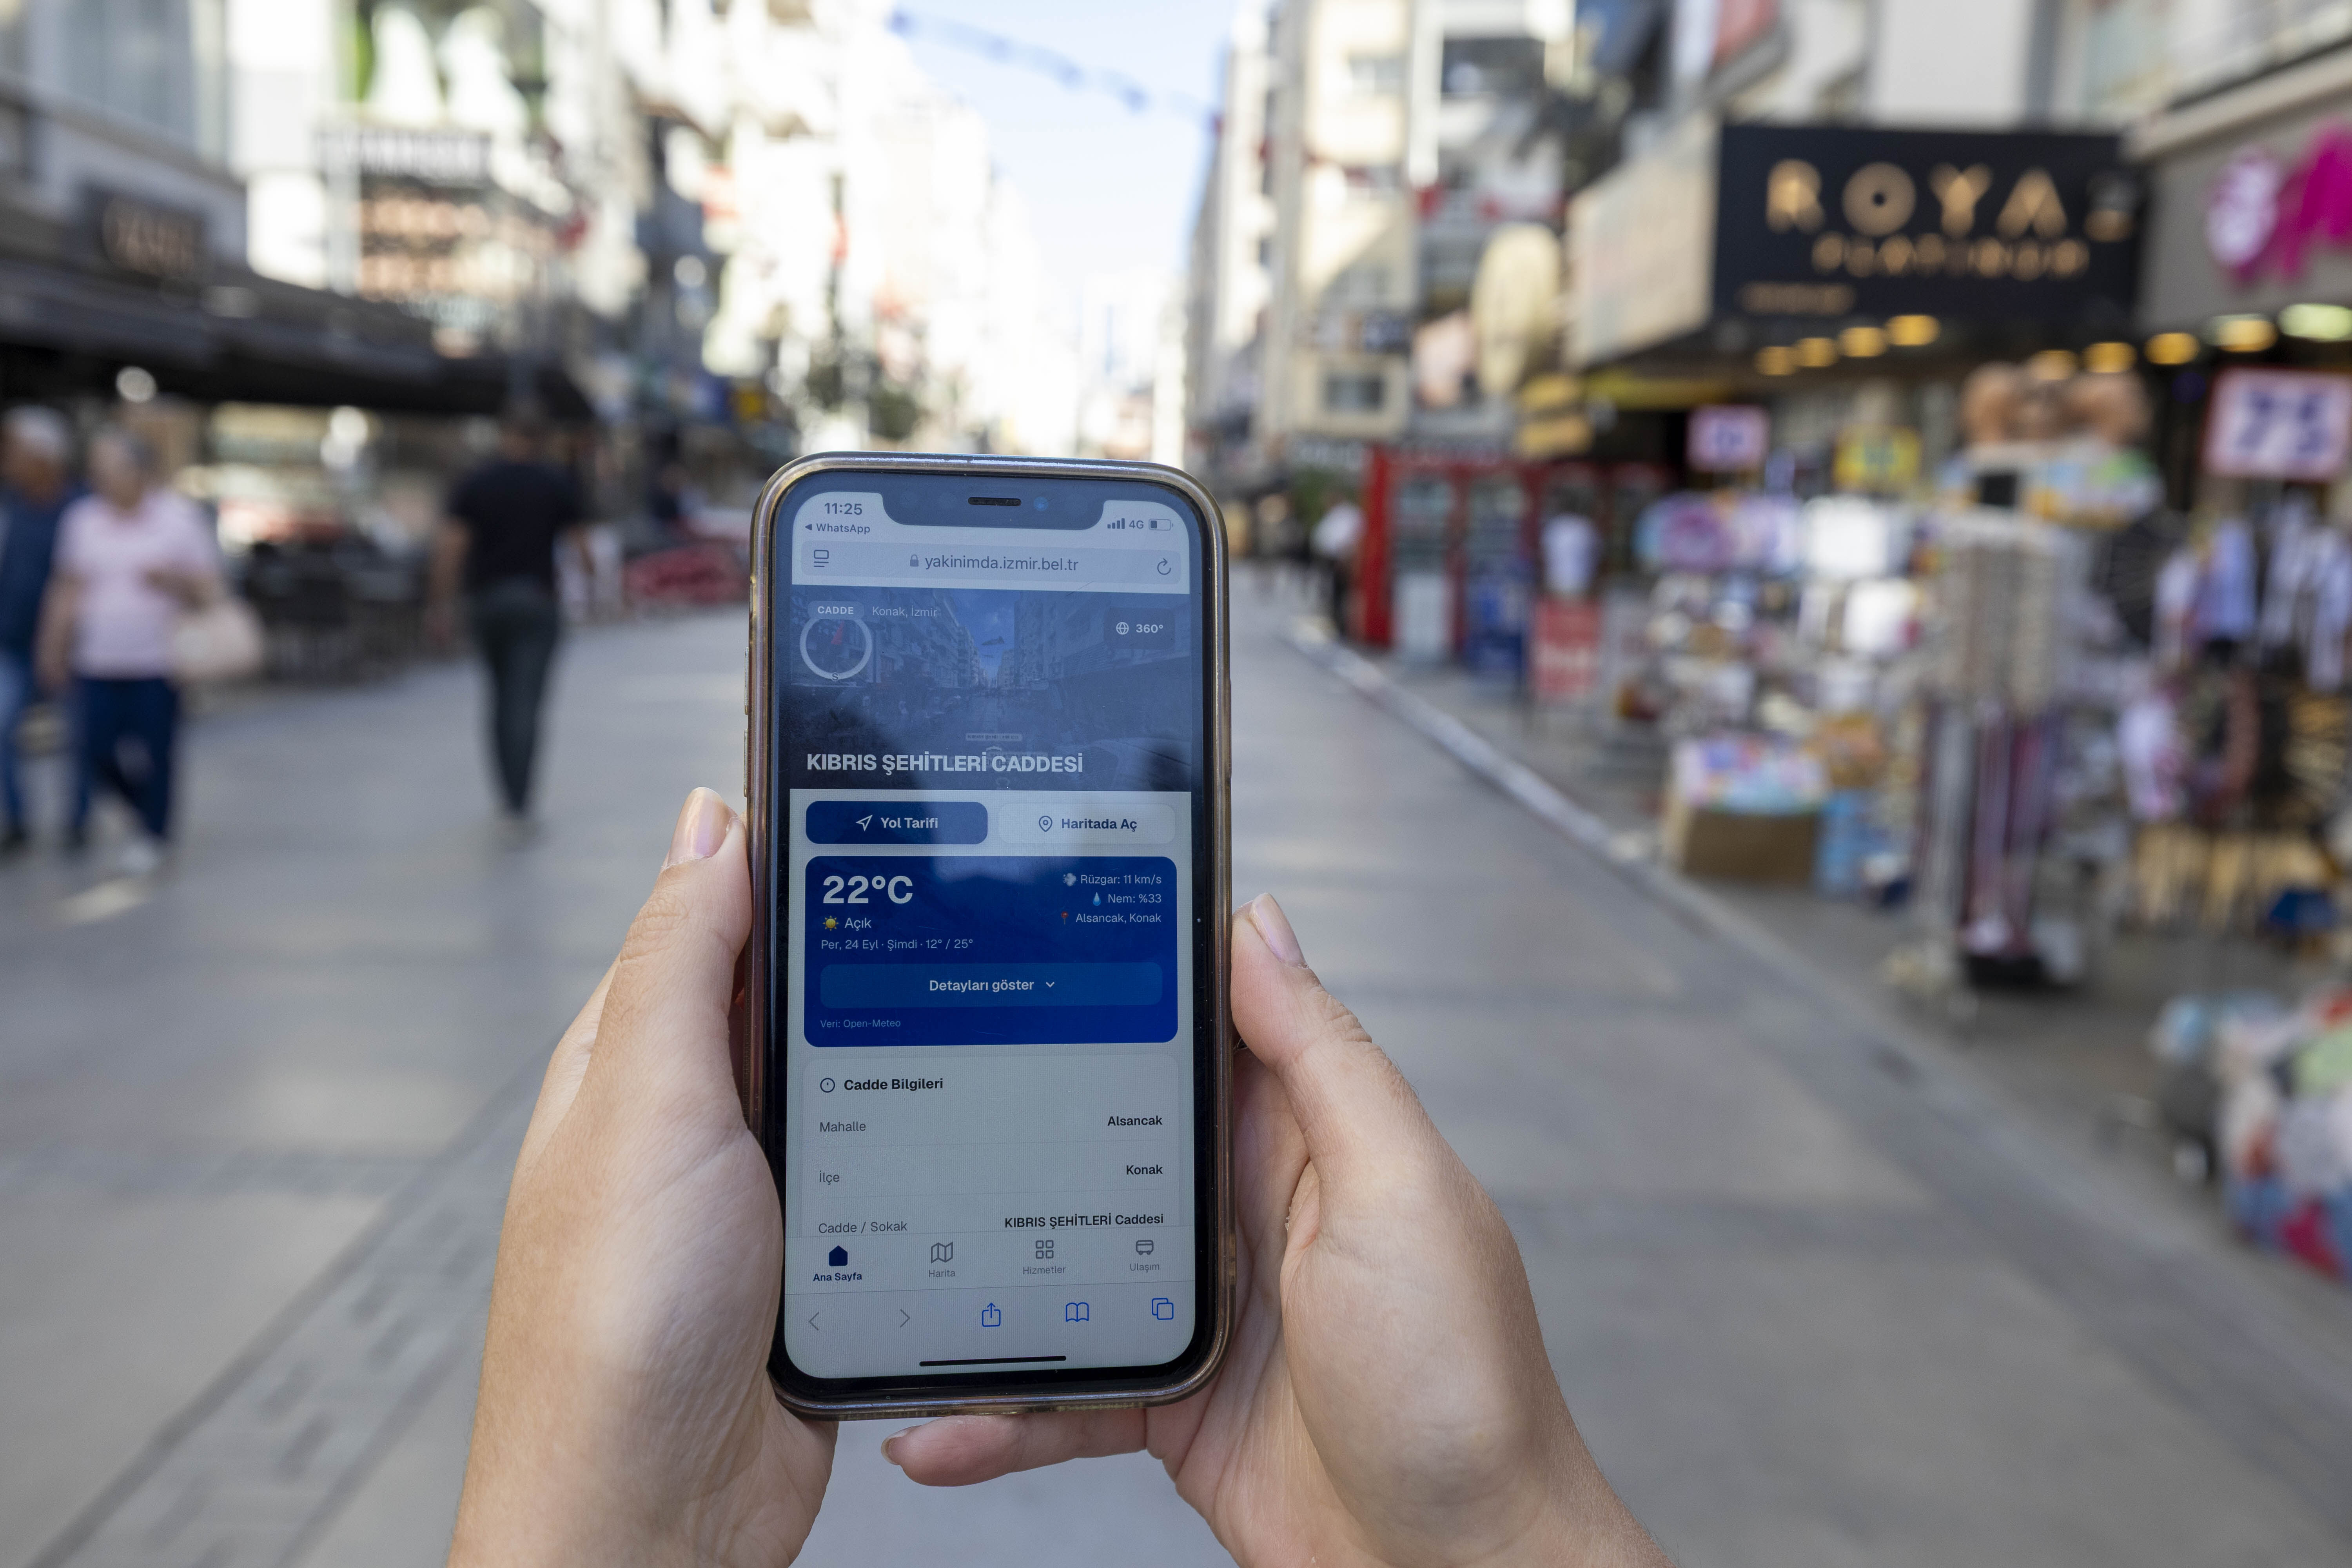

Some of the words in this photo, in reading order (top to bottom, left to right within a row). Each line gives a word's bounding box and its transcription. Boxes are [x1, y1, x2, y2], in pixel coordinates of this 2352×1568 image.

[1765, 158, 2070, 237] ROYA
[824, 503, 862, 515] 11:25
[816, 523, 871, 535] WhatsApp
[1129, 520, 1144, 529] 4G
[925, 555, 1079, 571] yakinimda.izmir.bel.tr
[817, 606, 853, 615] CADDE
[872, 606, 908, 618] Konak,
[910, 605, 938, 617] İzmir
[1136, 624, 1163, 633] 360°
[808, 754, 877, 770] KIBRIS
[882, 751, 986, 776] ŞEHİTLERİ
[991, 753, 1083, 773] CADDESİ
[880, 817, 902, 828] Yol
[904, 817, 938, 828] Tarifi
[1062, 818, 1117, 829] Haritada
[1120, 818, 1137, 832] Aç
[1080, 874, 1120, 886] Rüzgar:
[1123, 875, 1131, 884] 11
[1134, 874, 1162, 885] km/s
[823, 875, 913, 904] 22°C
[1108, 894, 1135, 903] Nem:
[1138, 893, 1162, 903] %33
[844, 917, 871, 931] Açık
[1075, 913, 1127, 924] Alsancak,
[1129, 913, 1161, 922] Konak
[821, 939, 842, 951] Per,
[845, 939, 859, 949] 24
[862, 939, 878, 951] Eyl
[887, 939, 917, 951] Şimdi
[926, 939, 942, 949] 12°
[954, 938, 973, 949] 25°
[929, 980, 988, 993] Detayları
[992, 979, 1034, 993] göster
[820, 1020, 840, 1028] Veri:
[843, 1019, 901, 1029] Open-Meteo
[844, 1079, 888, 1091] Cadde
[891, 1078, 943, 1091] Bilgileri
[820, 1121, 866, 1132] Mahalle
[1107, 1115, 1162, 1126] Alsancak
[1126, 1164, 1163, 1175] Konak
[819, 1170, 840, 1185] İlçe
[1005, 1217, 1046, 1228] KIBRIS
[1049, 1212, 1111, 1230] ŞEHİTLERİ
[1115, 1213, 1163, 1225] Caddesi
[818, 1222, 857, 1234] Cadde
[871, 1221, 907, 1232] Sokak
[929, 1269, 956, 1278] Harita
[1023, 1266, 1066, 1275] Hizmetler
[1129, 1263, 1160, 1273] Ulaşım
[813, 1273, 832, 1281] Ana
[835, 1272, 862, 1283] Sayfa
